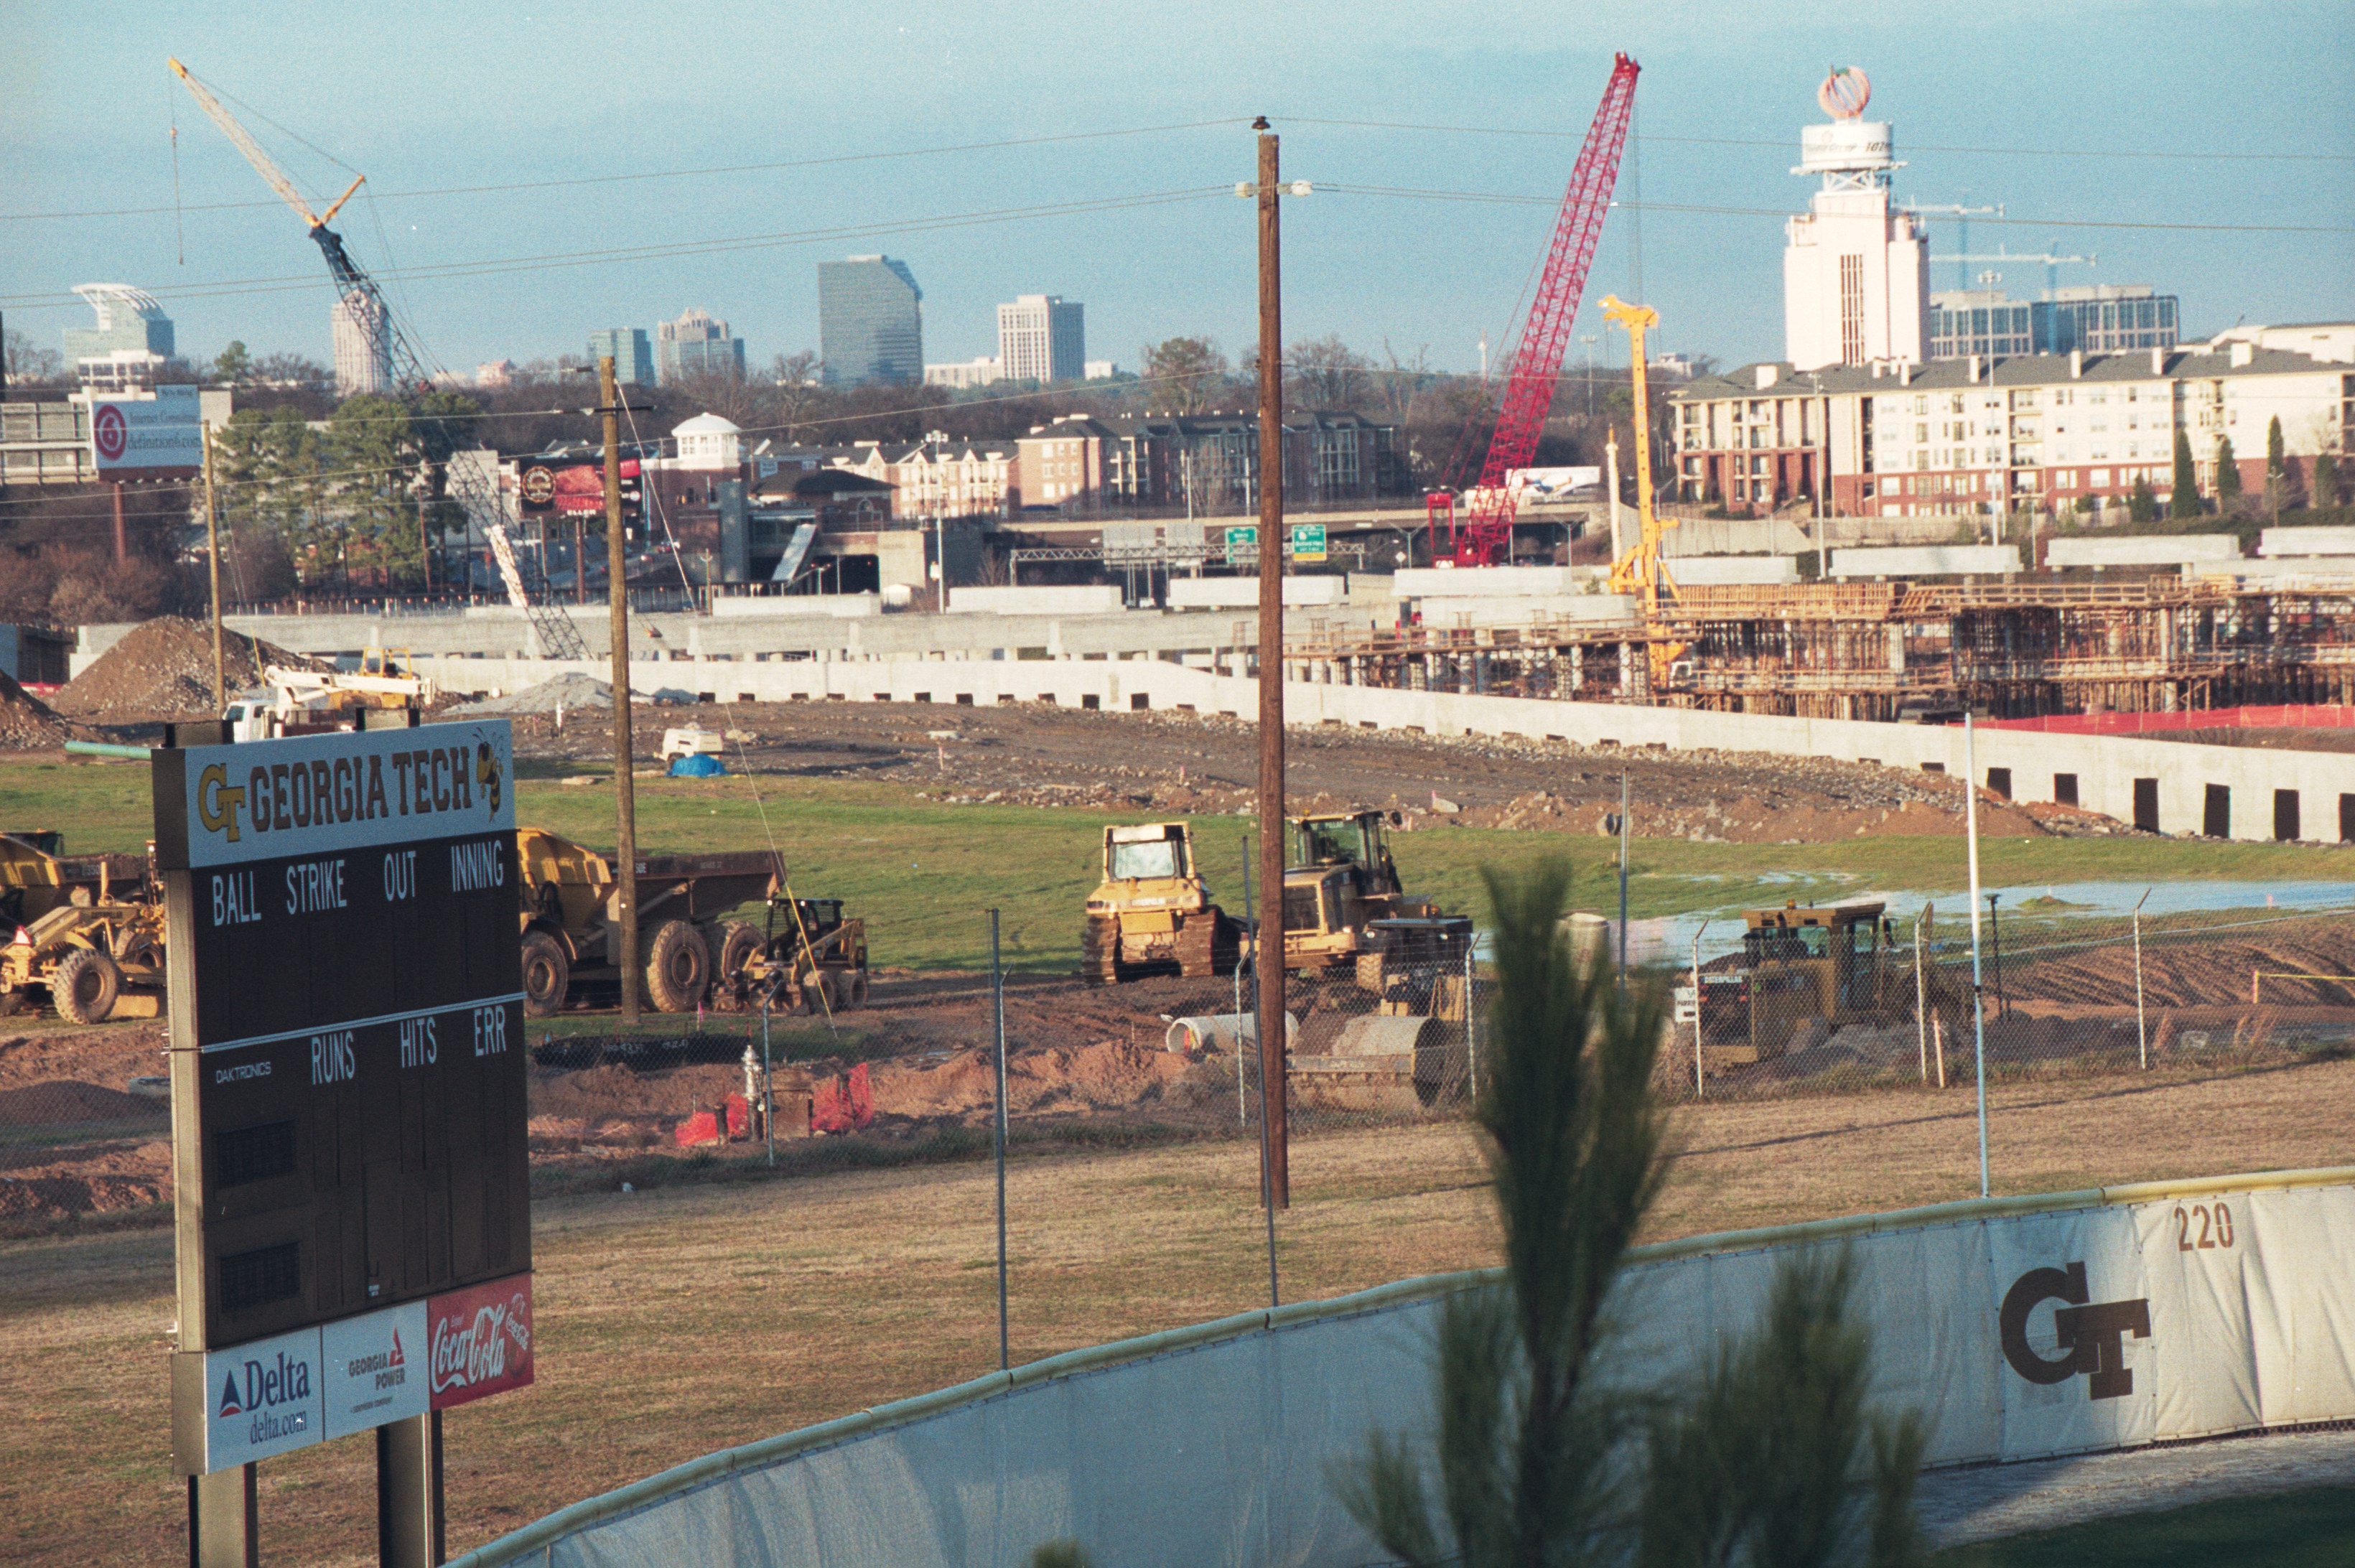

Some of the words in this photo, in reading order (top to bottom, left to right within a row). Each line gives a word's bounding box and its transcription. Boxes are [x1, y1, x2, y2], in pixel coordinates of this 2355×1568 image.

[250, 752, 389, 833] GEORGIA
[392, 746, 472, 816] TECH
[213, 871, 261, 927] BALL
[286, 859, 348, 915] STRIKE
[383, 850, 417, 902] OUT
[451, 839, 504, 892] INNING
[215, 1060, 271, 1084] DAKTRONICS
[311, 1030, 355, 1086] RUNS
[400, 1016, 437, 1068] HITS
[474, 1004, 507, 1058] ERR
[2174, 1202, 2234, 1252] 220
[431, 1302, 506, 1394] Coca-Cola
[1999, 1261, 2152, 1401] GT
[244, 1351, 311, 1412] Delta
[348, 1352, 388, 1378] GEORGIA
[375, 1367, 406, 1391] POWER
[249, 1409, 308, 1445] delta.com
